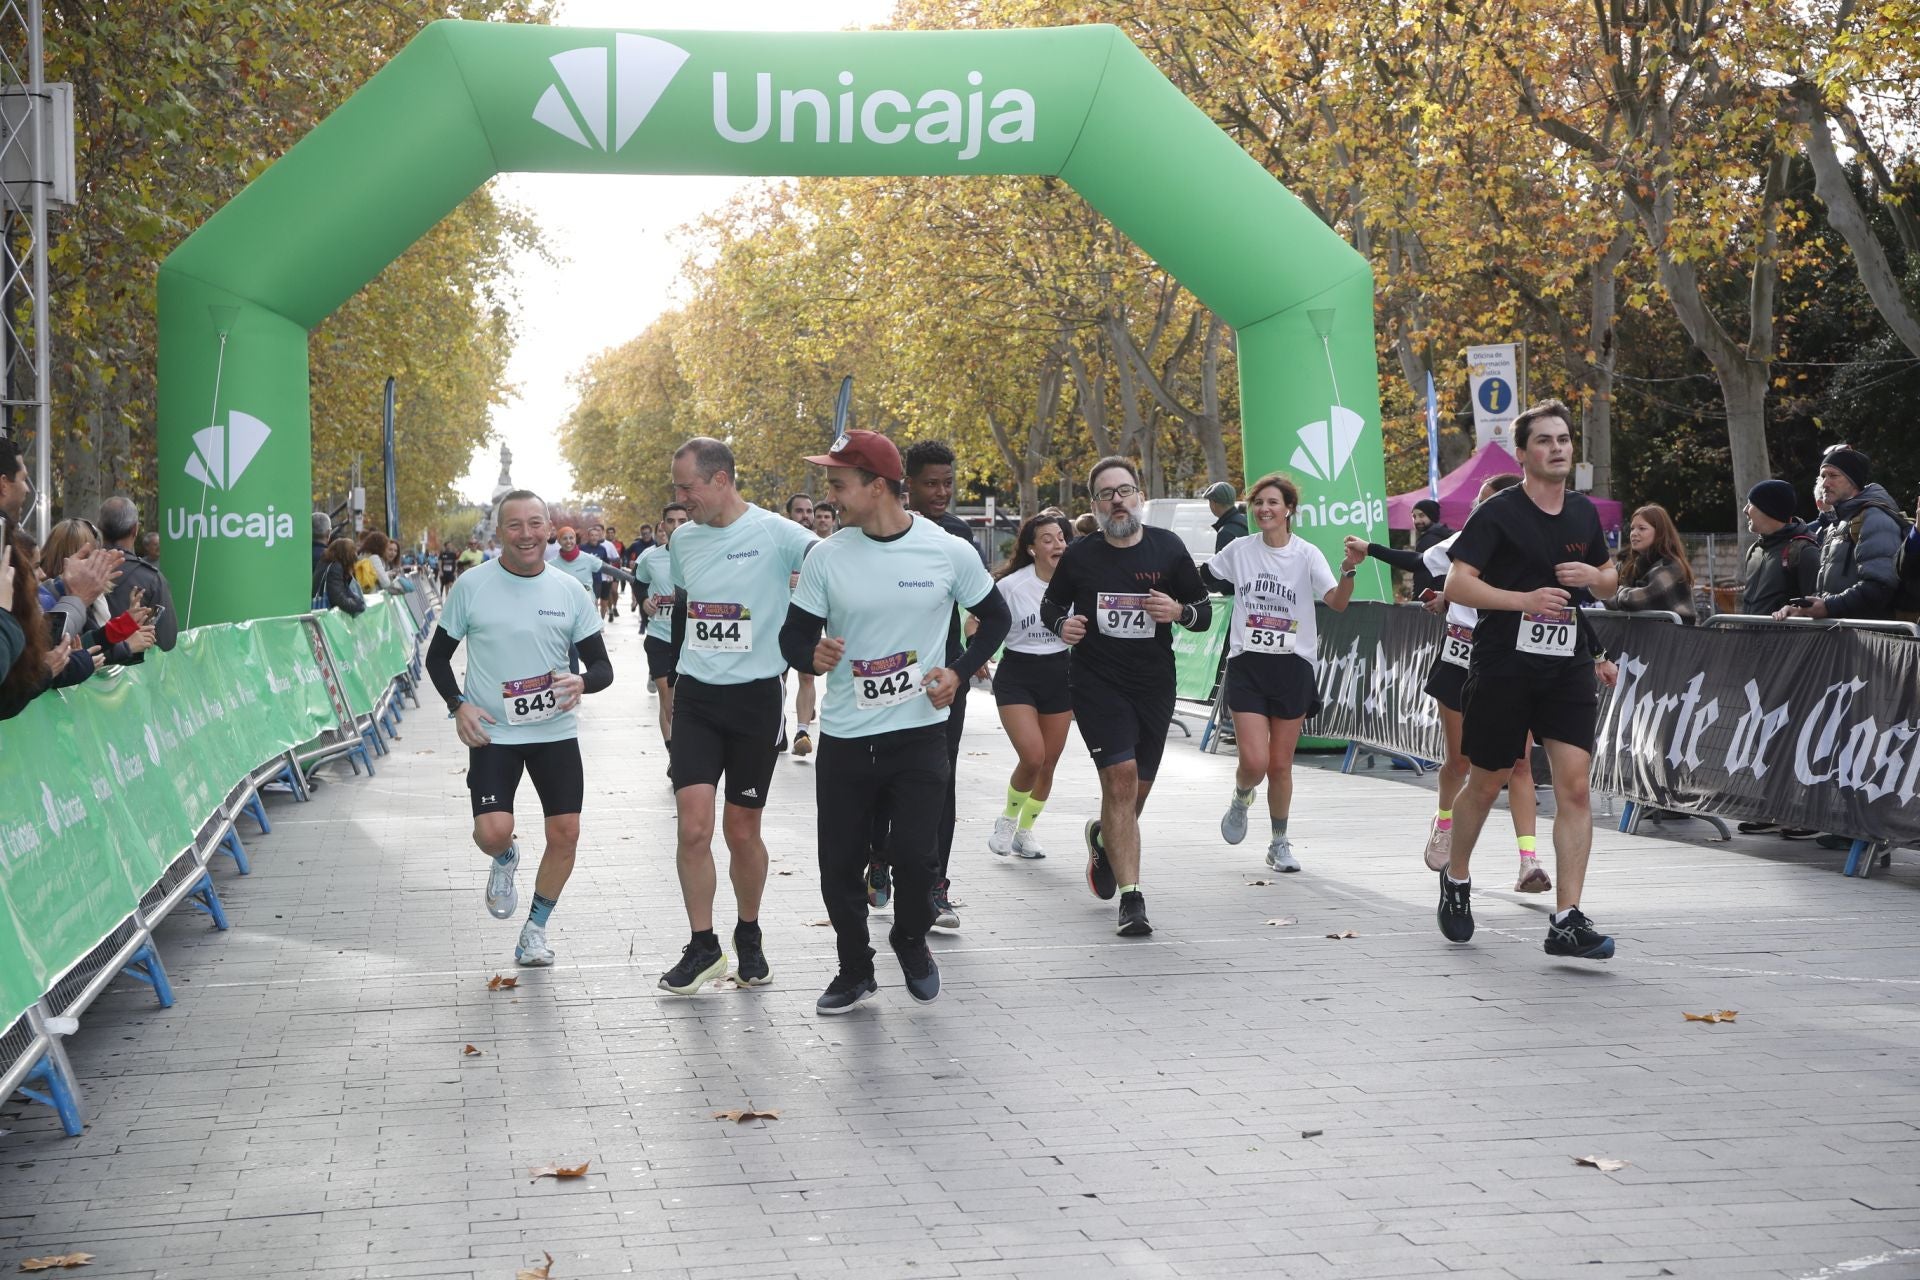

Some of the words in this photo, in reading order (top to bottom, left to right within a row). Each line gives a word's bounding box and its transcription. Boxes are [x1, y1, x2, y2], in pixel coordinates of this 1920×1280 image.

[712, 71, 1036, 161] Unicaja
[1295, 492, 1384, 532] nicaja
[167, 505, 293, 547] Unicaja
[727, 549, 759, 560] OneHealth
[898, 580, 935, 588] OneHealth
[1255, 580, 1296, 605] HORTEGA
[538, 609, 566, 618] OneHealth
[658, 605, 676, 616] 77
[1245, 602, 1289, 613] UIVERSITARIO
[1107, 610, 1146, 629] 974
[696, 621, 741, 642] 844
[1251, 629, 1285, 648] 531
[1530, 624, 1568, 646] 970
[863, 671, 913, 699] 842
[514, 690, 556, 716] 843
[1596, 651, 1719, 773] Norte
[1723, 678, 1790, 780] de
